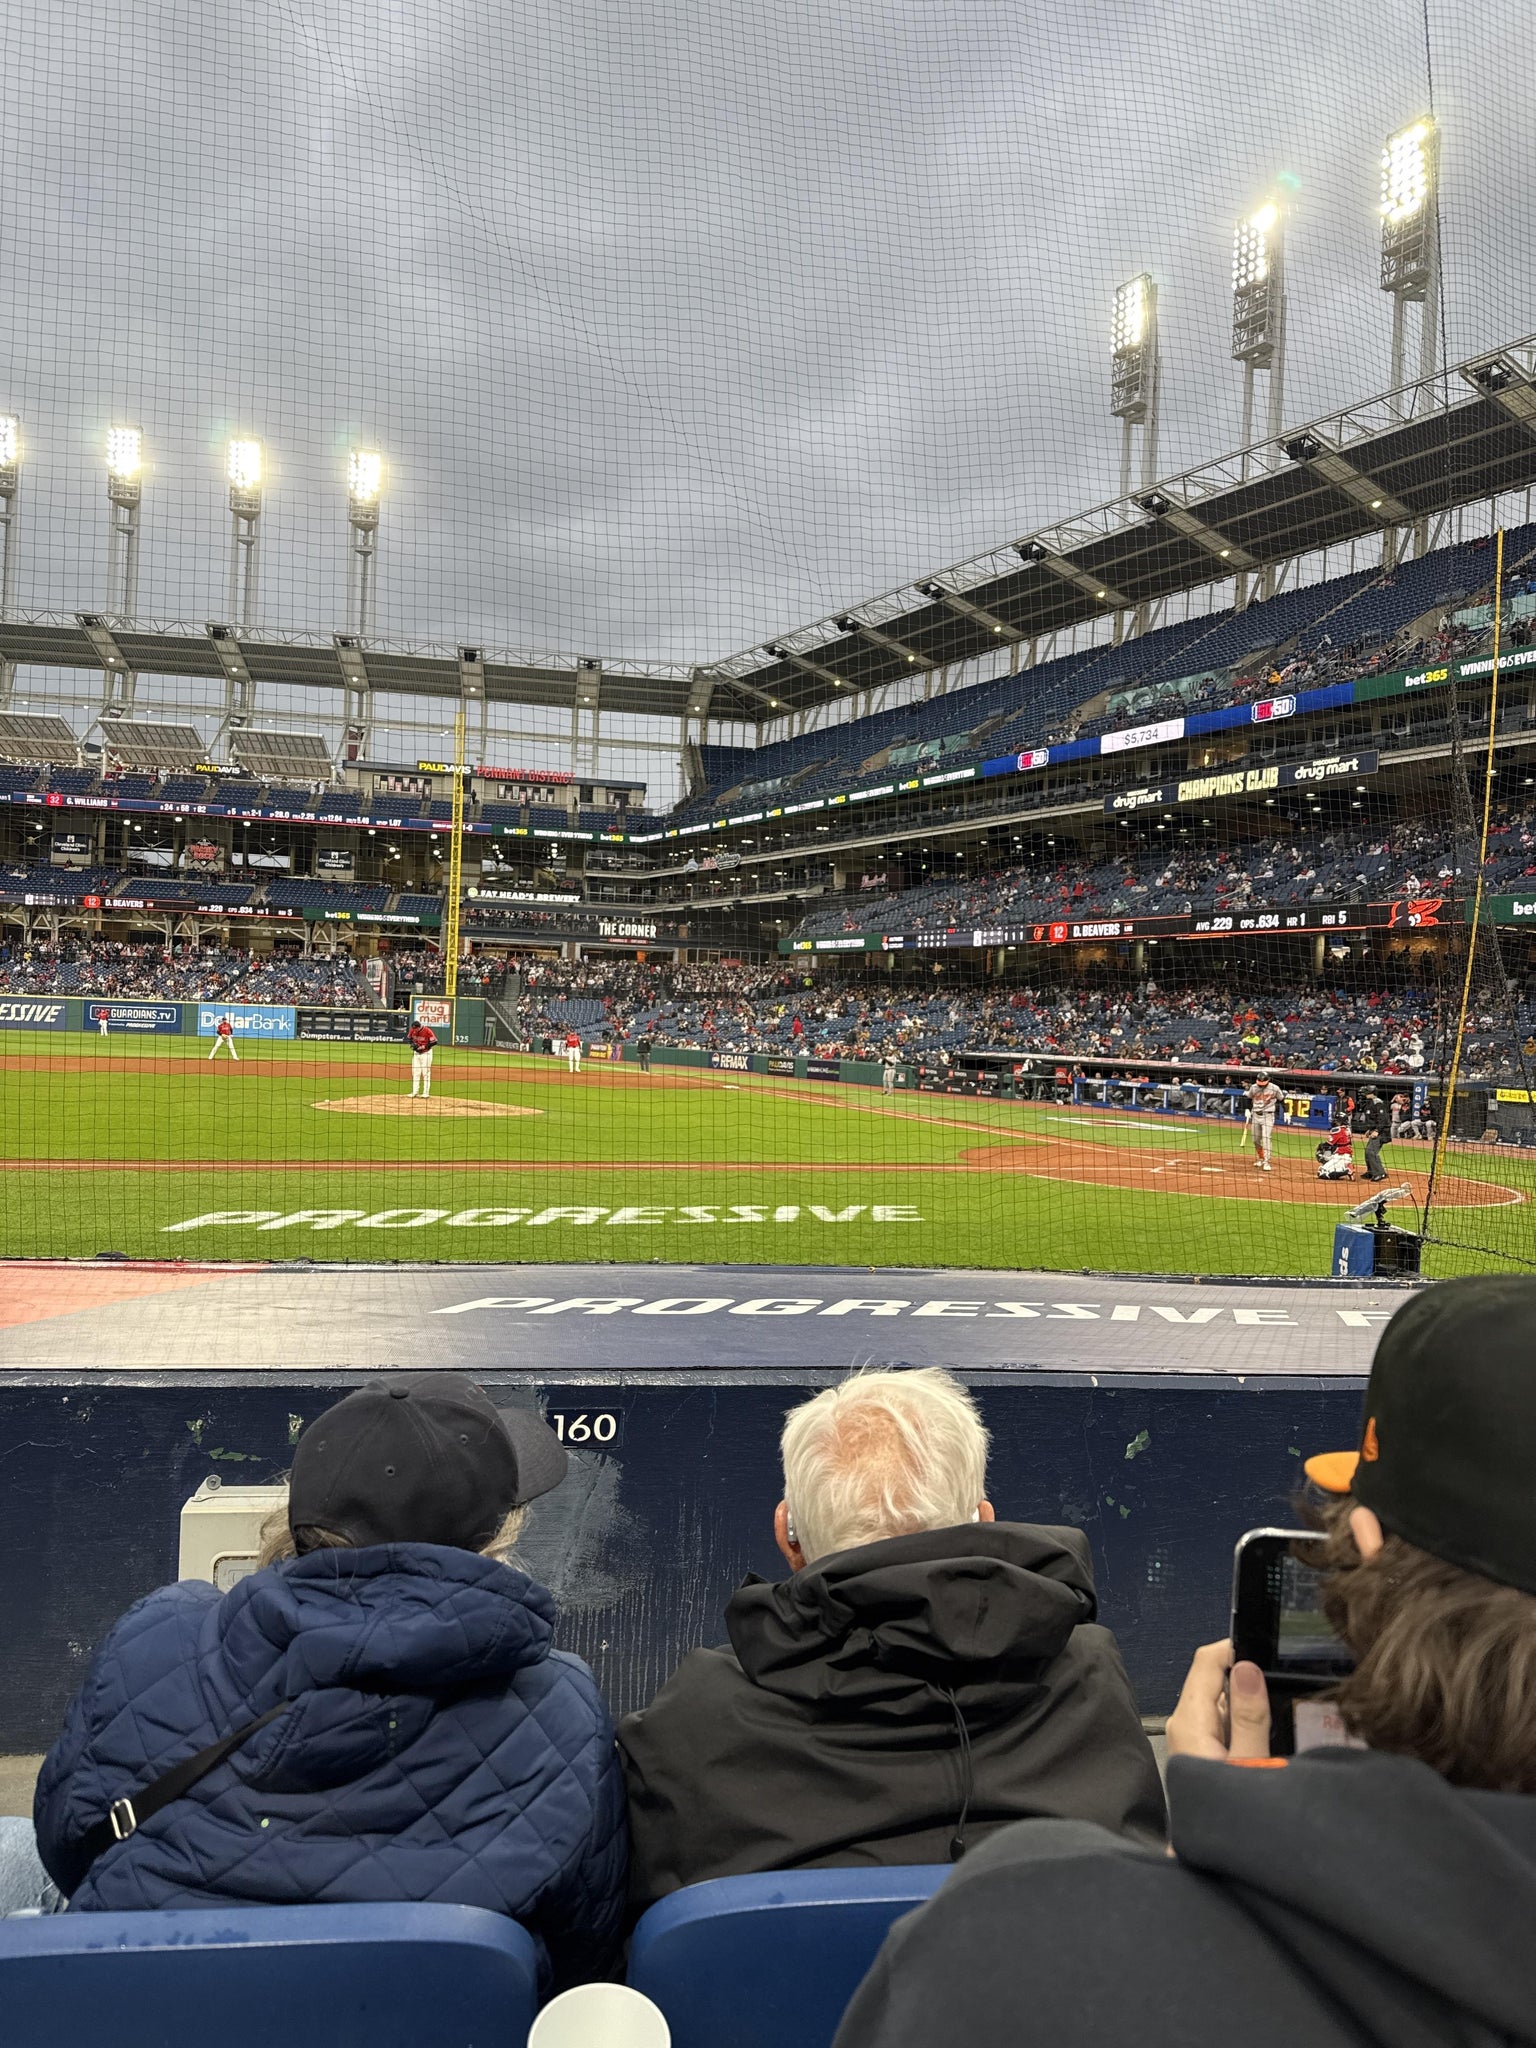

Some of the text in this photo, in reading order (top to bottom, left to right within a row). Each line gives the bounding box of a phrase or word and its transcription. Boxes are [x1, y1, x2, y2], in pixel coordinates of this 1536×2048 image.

[1405, 669, 1448, 687] bet365
[1124, 728, 1158, 746] $5,734
[477, 766, 576, 784] PENNANT DISTRICT
[1295, 758, 1358, 780] drug mart
[1178, 767, 1279, 801] CHAMPIONS CLUB
[50, 796, 60, 804] 32
[74, 798, 108, 807] WILLIAMS
[1113, 791, 1162, 808] drug mart
[88, 898, 96, 906] 12
[536, 894, 580, 902] BREWERY
[600, 922, 656, 938] THE CORNER
[1053, 926, 1064, 938] 12
[1073, 926, 1082, 937] D.
[1082, 923, 1120, 937] BEAVERS
[1196, 922, 1210, 931] AVG
[1211, 917, 1233, 930] .229
[1240, 919, 1254, 929] OPS
[1256, 914, 1280, 928] .634
[1286, 917, 1298, 926] HR
[1300, 913, 1306, 926] 1
[1322, 914, 1335, 925] RBI
[1338, 911, 1346, 924] 5
[0, 1004, 61, 1022] ESSIVE
[418, 1000, 444, 1015] drug
[420, 1015, 450, 1023] mart
[159, 1205, 925, 1232] PROGRESSIVE
[428, 1297, 1299, 1326] PROGRESSIVE
[554, 1414, 616, 1442] 160
